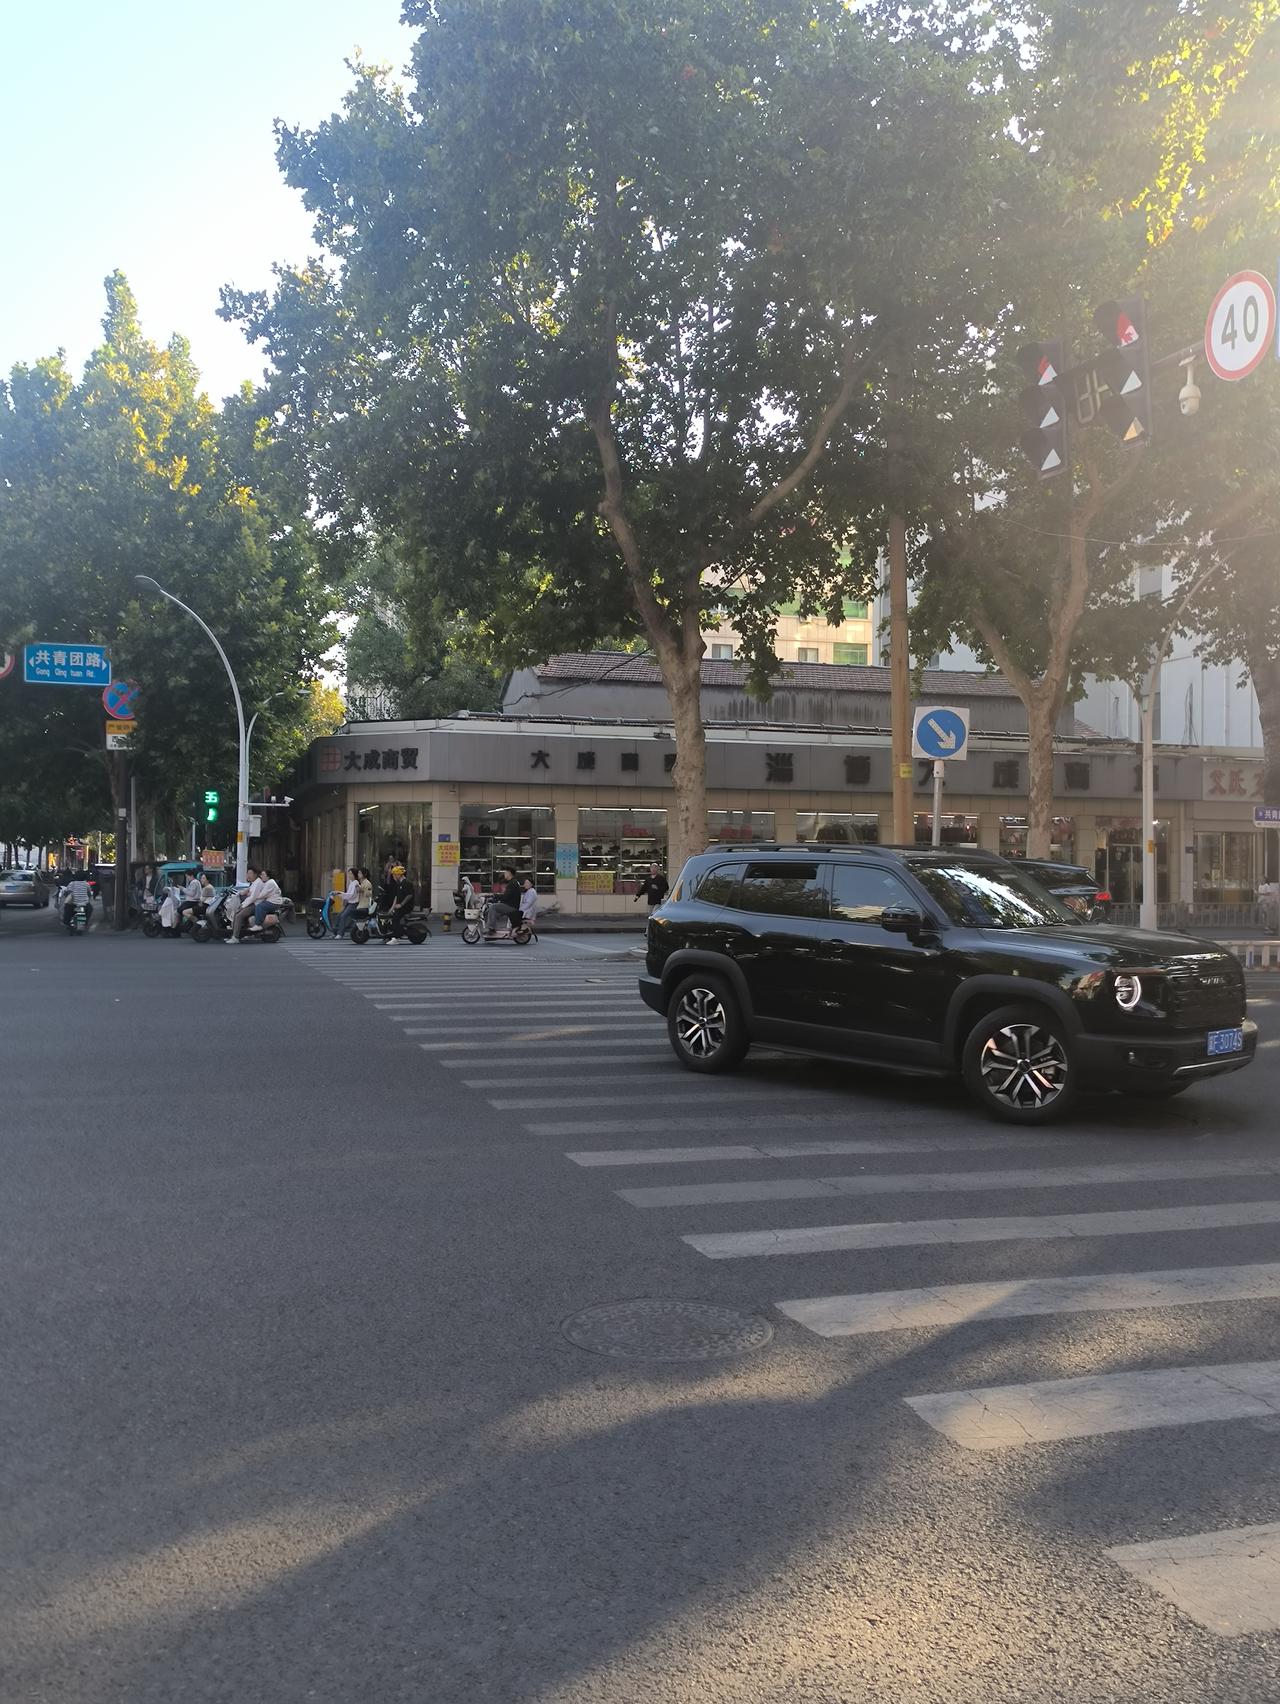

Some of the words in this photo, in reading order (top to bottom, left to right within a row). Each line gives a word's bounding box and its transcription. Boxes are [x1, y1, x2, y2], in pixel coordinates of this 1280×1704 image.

[1221, 295, 1259, 350] 40
[35, 650, 100, 667] 共青团路
